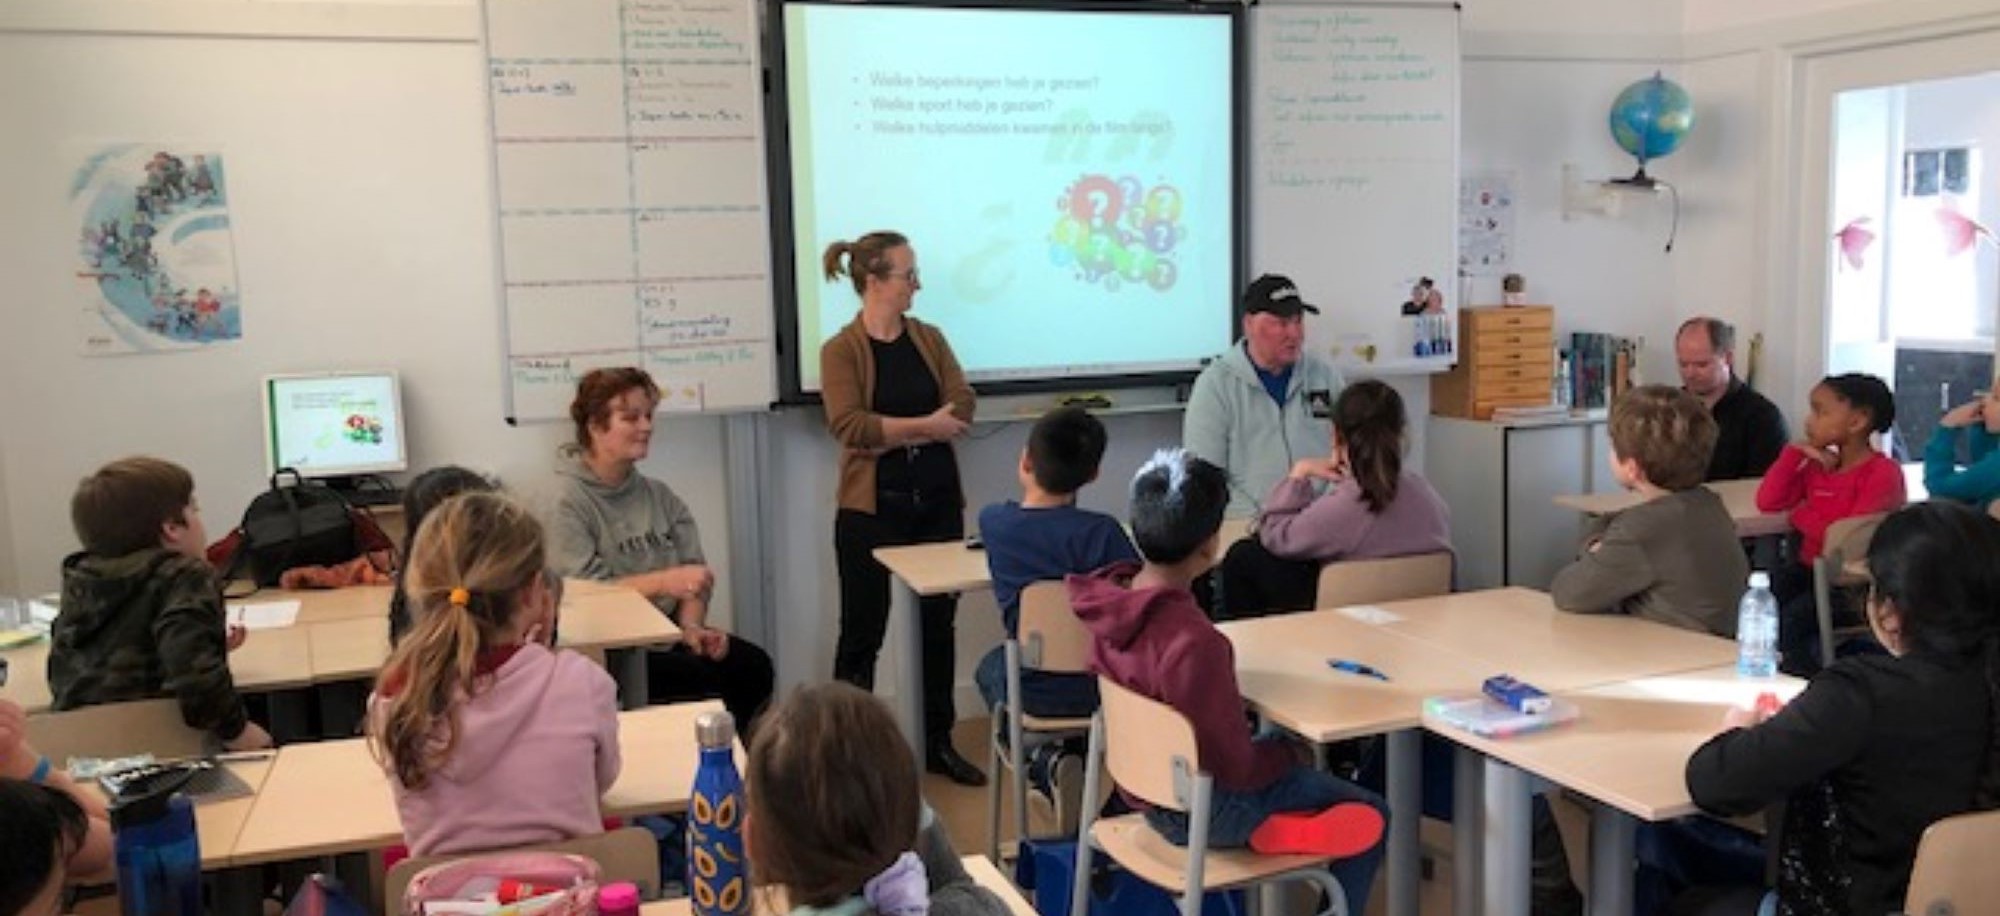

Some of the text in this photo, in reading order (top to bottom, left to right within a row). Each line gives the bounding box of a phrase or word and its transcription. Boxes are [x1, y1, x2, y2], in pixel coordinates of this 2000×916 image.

[870, 71, 914, 87] Welke
[1004, 76, 1028, 88] heb
[871, 97, 1054, 114] Welke sport heb je gezien?
[872, 120, 914, 134] Welke
[919, 120, 1009, 136] hulpmiddelen
